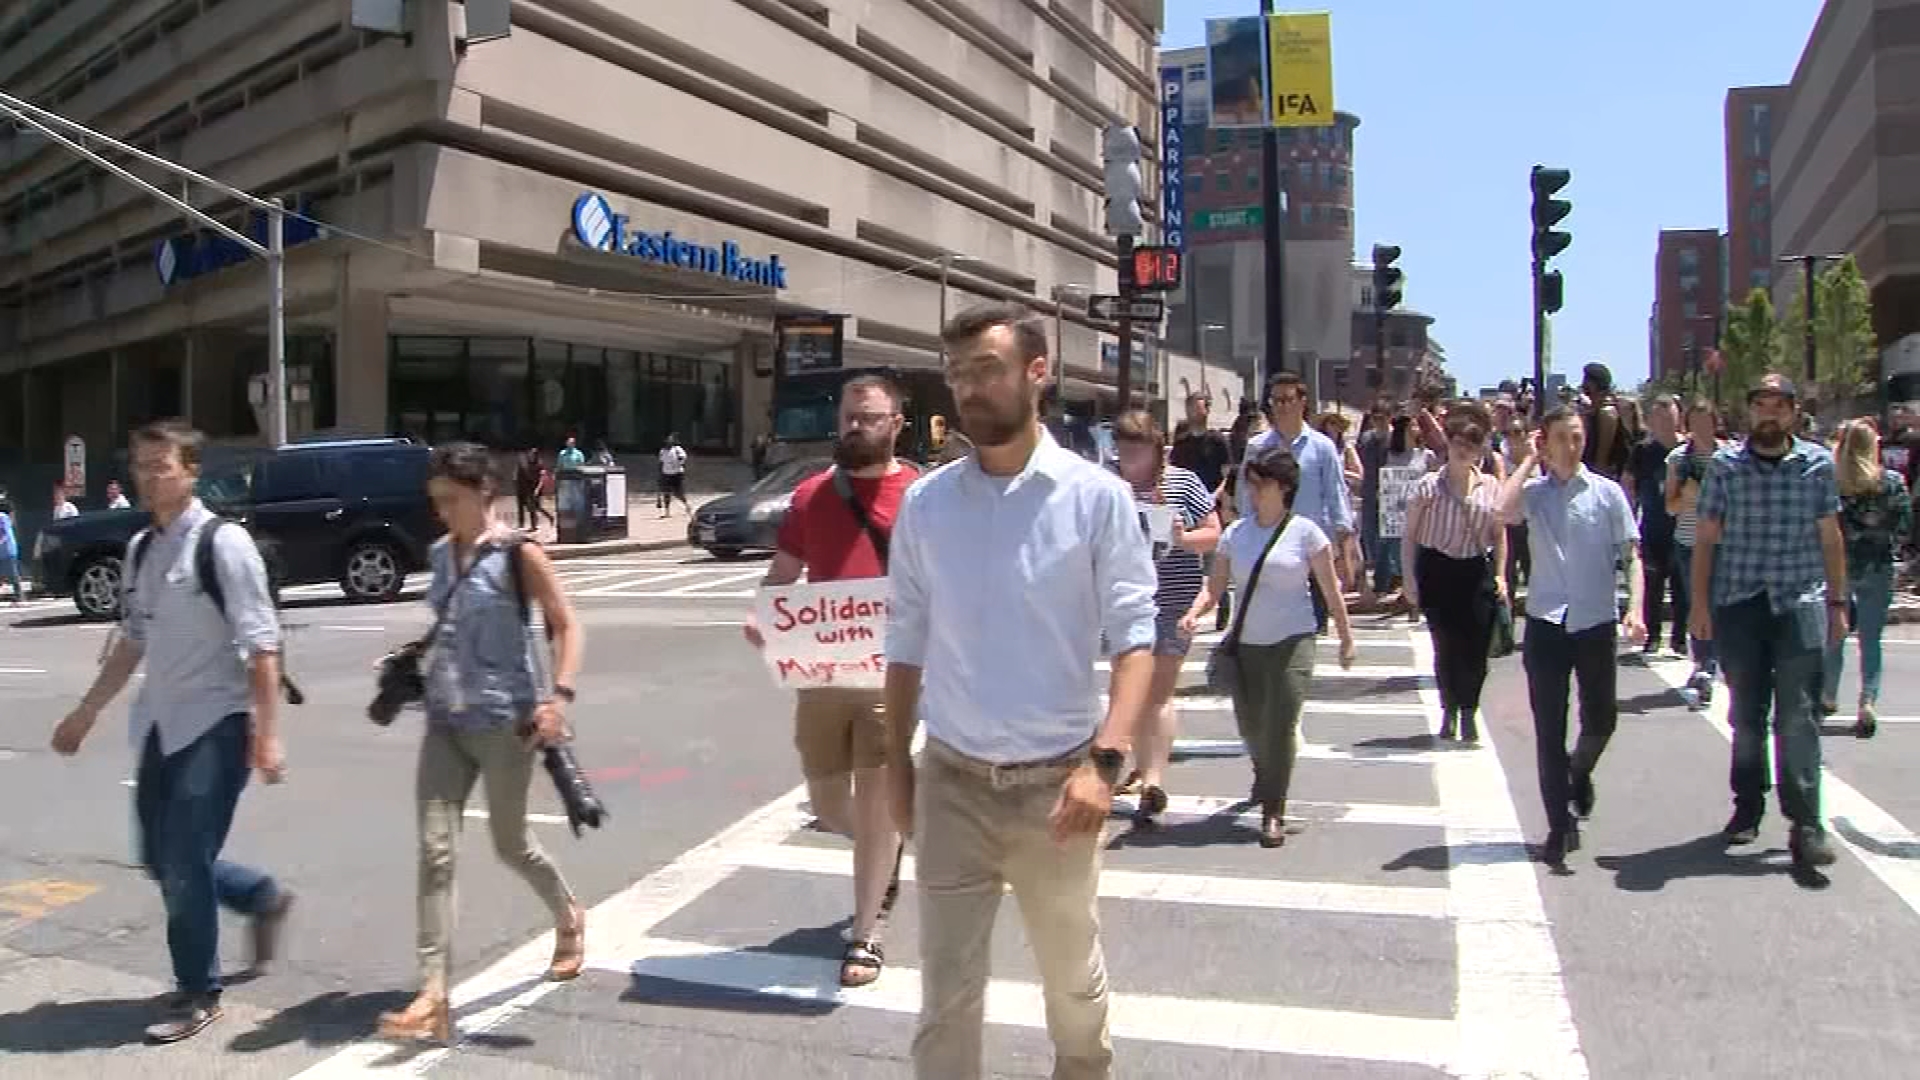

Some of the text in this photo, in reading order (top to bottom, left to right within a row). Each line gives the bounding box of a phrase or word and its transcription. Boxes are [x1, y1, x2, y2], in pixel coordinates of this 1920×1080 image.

[1165, 108, 1182, 248] PARKING
[613, 213, 788, 289] Eastern Bank
[815, 626, 874, 644] with
